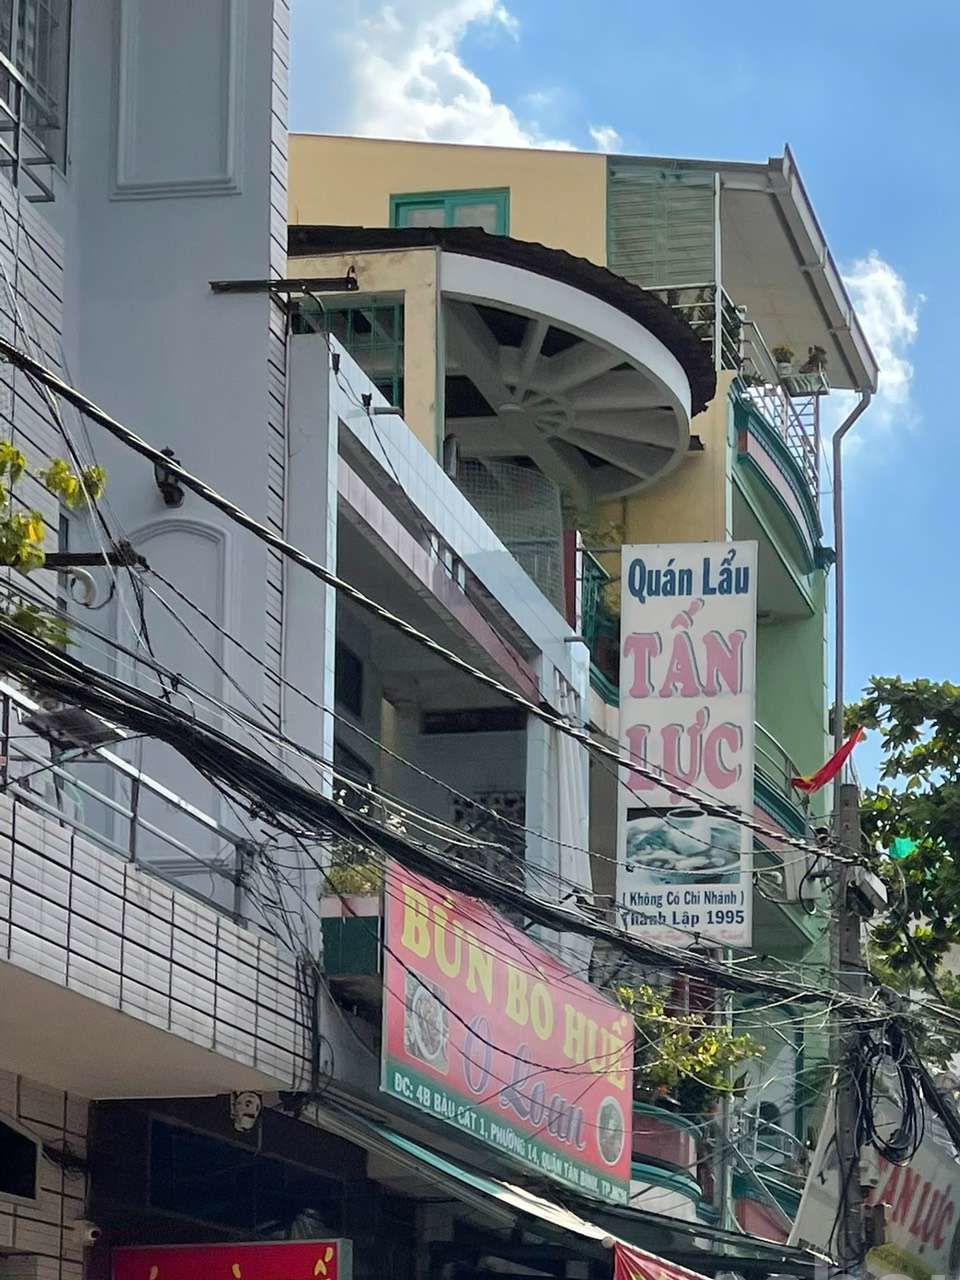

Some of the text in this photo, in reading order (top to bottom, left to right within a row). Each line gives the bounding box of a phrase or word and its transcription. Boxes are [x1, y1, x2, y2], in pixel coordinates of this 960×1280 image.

[628, 549, 750, 602] Quán Lẩu
[623, 598, 746, 698] TẤN
[624, 705, 743, 804] LỰC
[672, 911, 699, 928] Lập
[707, 910, 745, 925] 1995
[684, 890, 700, 905] Chi
[401, 882, 495, 1004] BÚN
[564, 1004, 628, 1091] HUẾ
[416, 1085, 431, 1106] 4B
